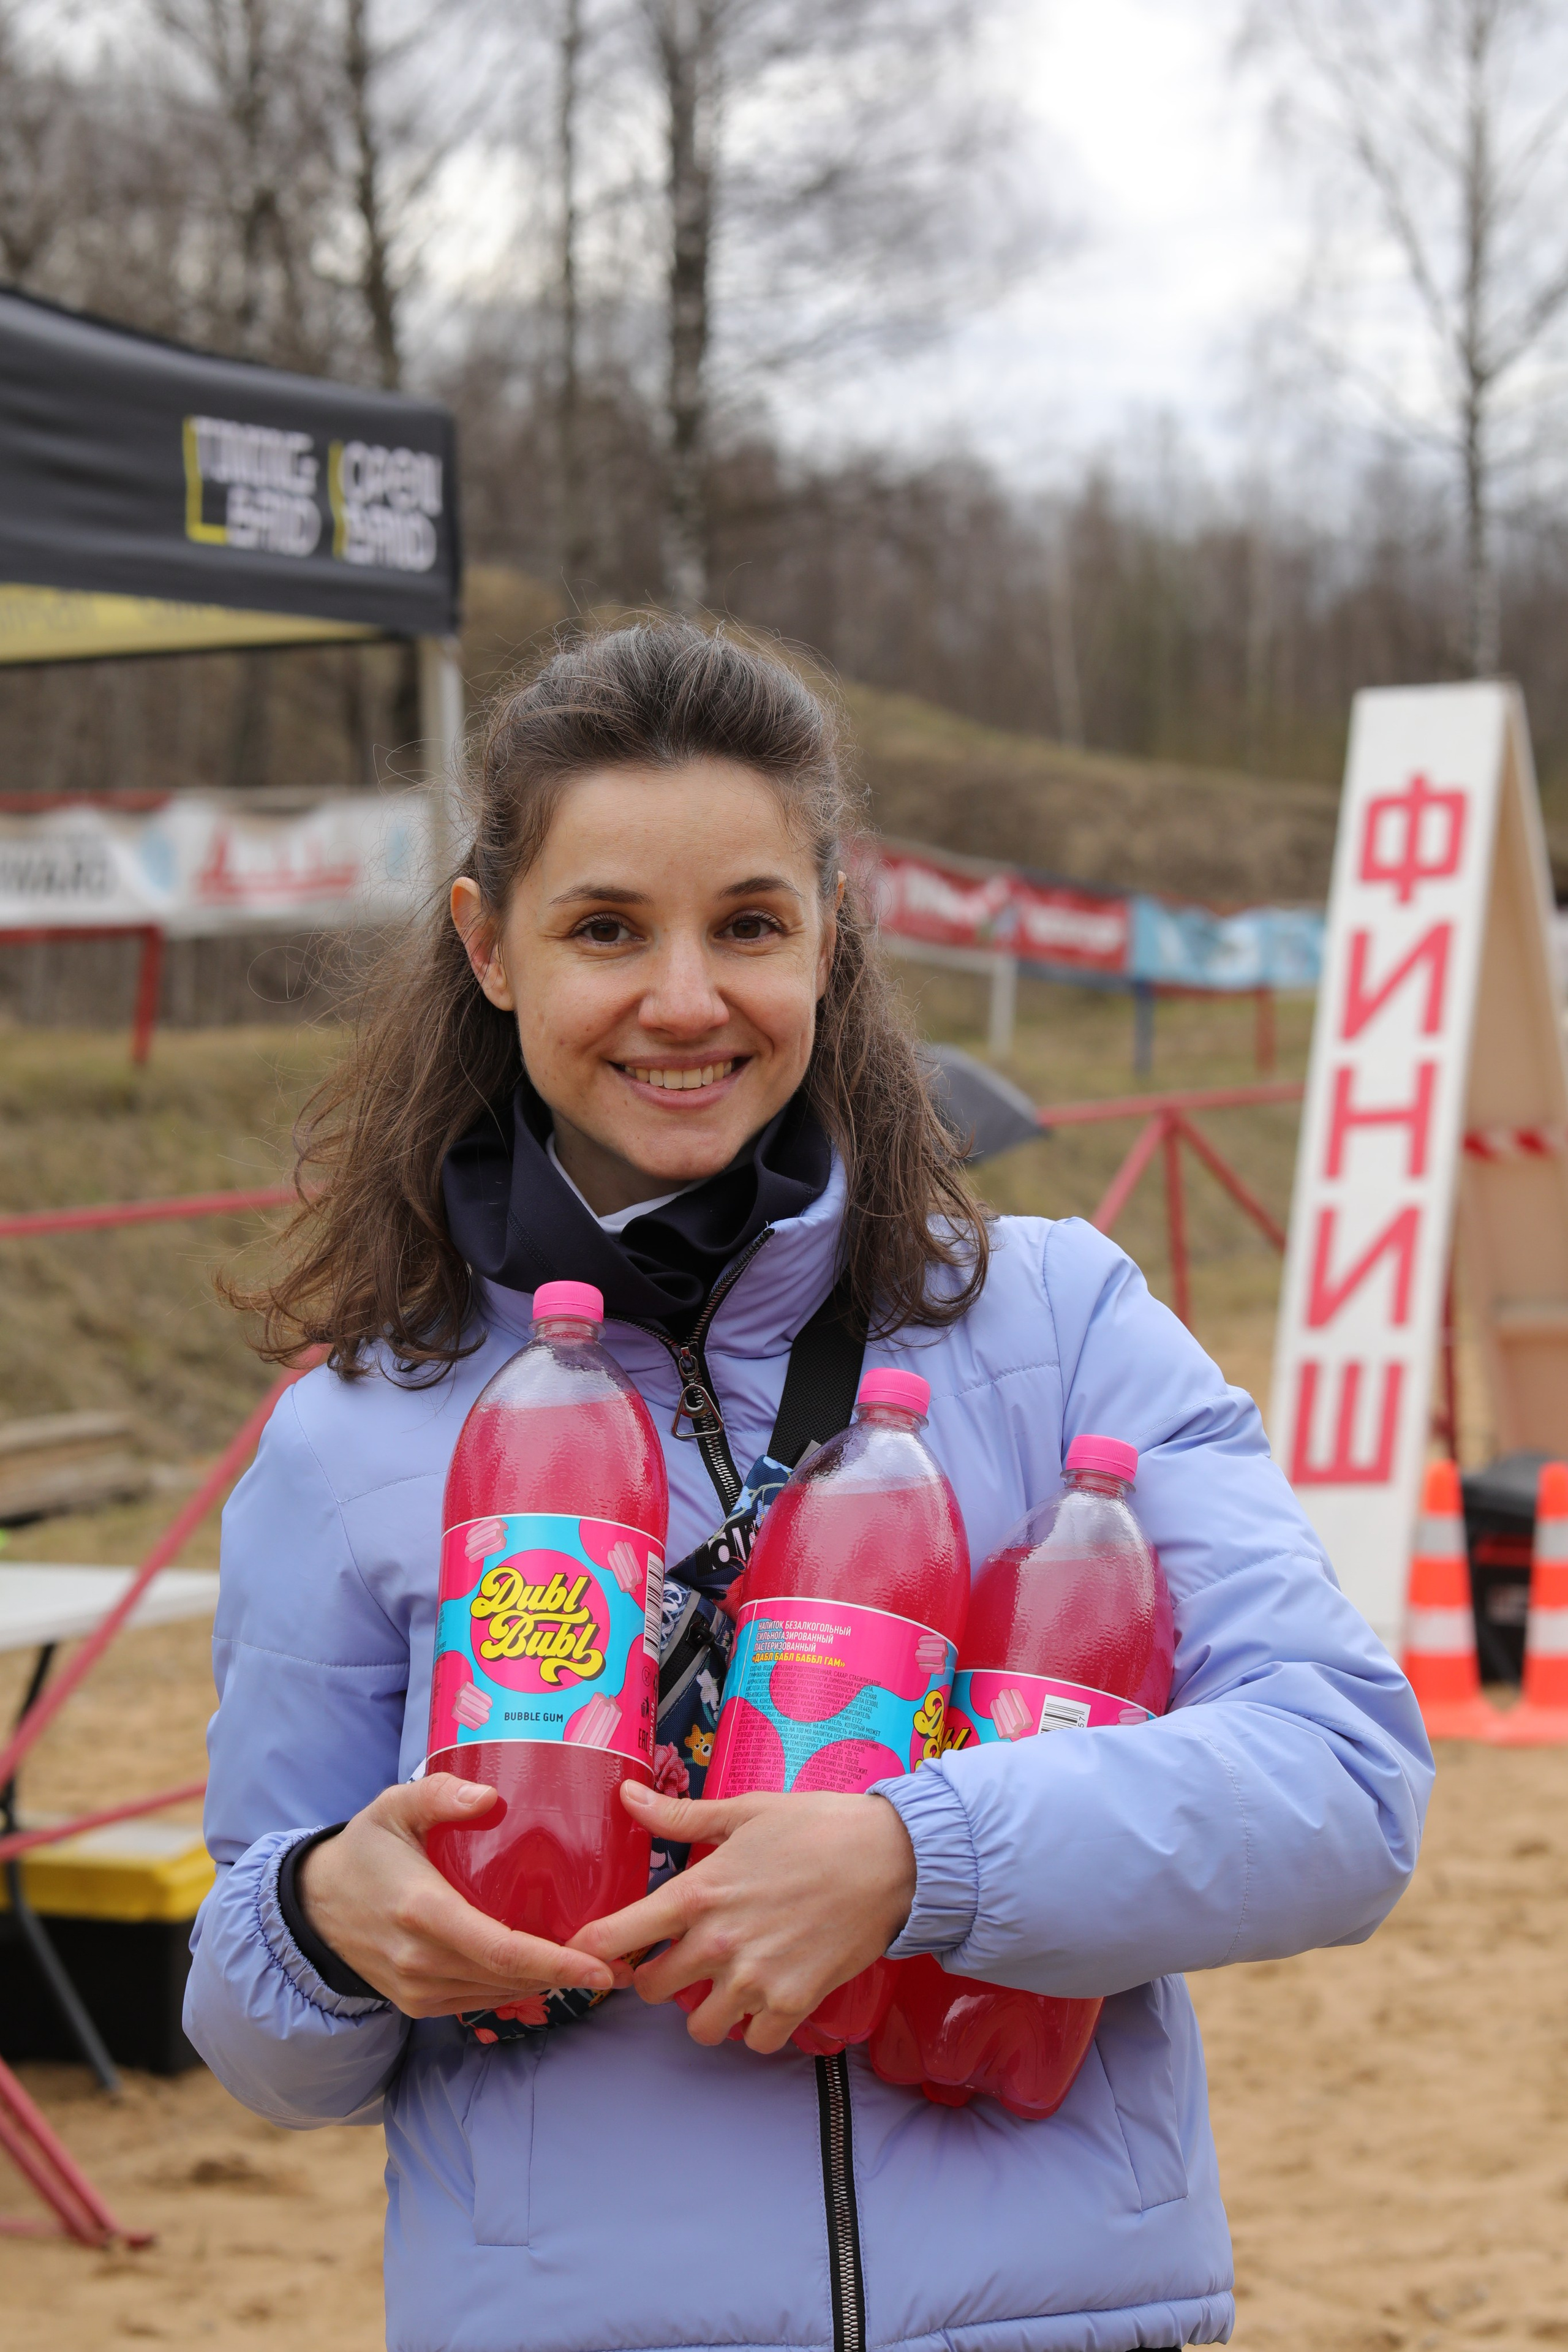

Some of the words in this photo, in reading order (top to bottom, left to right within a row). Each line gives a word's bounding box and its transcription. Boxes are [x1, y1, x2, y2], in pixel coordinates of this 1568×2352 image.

[1289, 773, 1468, 1487] ФИНИШ
[470, 1566, 592, 1621] Dubl
[758, 1621, 784, 1630] НАПИТОК
[785, 1619, 851, 1636] БЕЗАЛКОГОЛЬНЫЙ
[756, 1630, 834, 1645] СИЛЬНОГАЗИРОВАННЫЙ
[480, 1606, 606, 1686] Bubl
[754, 1640, 816, 1653] ПАСТЕРИЗОВАННЫЙ
[752, 1653, 773, 1662] «ДАБЛ
[774, 1653, 794, 1661] БАБЛ
[795, 1653, 823, 1664] БАББЛ
[824, 1656, 846, 1668] ГАМ»
[797, 1673, 827, 1681] КИСЛОТНОСТИ
[829, 1676, 853, 1686] ЛИМОННАЯ
[849, 1673, 881, 1687] СТАБИЛИЗАТОР
[810, 1687, 843, 1698] АСКОРБИНОВАЯ
[845, 1694, 864, 1703] КИСЛОТА
[824, 1683, 855, 1694] КИСЛОТНОСТИ
[856, 1689, 876, 1700] УКСУСНАЯ
[815, 1695, 840, 1705] СМОЛЯНЫХ
[841, 1700, 858, 1709] КИСЛОТ
[504, 1712, 541, 1722] BUBBLE
[543, 1713, 564, 1722] GUM
[802, 1707, 827, 1716] КРАСИТЕЛЬ
[828, 1711, 851, 1721] АЗОРУБИН
[831, 1705, 871, 1720] АНТИОКИСЛИТЕЛЬ
[793, 1713, 816, 1722] СОДЕРЖИТ
[845, 1721, 865, 1732] КОТОРЫЙ
[865, 1727, 880, 1737] МОЖЕТ
[799, 1735, 822, 1743] ЦЕННОСТЬ
[813, 1729, 833, 1738] НАПИТКА
[820, 1724, 847, 1734] АКТИВНОСТЬ
[853, 1731, 875, 1743] ВНИМАНИЕ
[790, 1740, 819, 1749] ТЕМПЕРАТУРЕ
[800, 1748, 829, 1758] СОЛНЕЧНОГО
[845, 1757, 859, 1766] ПОСЛЕ
[812, 1757, 836, 1767] ХРАНЕНИЮ
[821, 1765, 846, 1776] ОКОНЧАНИЯ
[848, 1772, 862, 1781] СРОКА
[805, 1777, 835, 1788] МОСКОВСКАЯ
